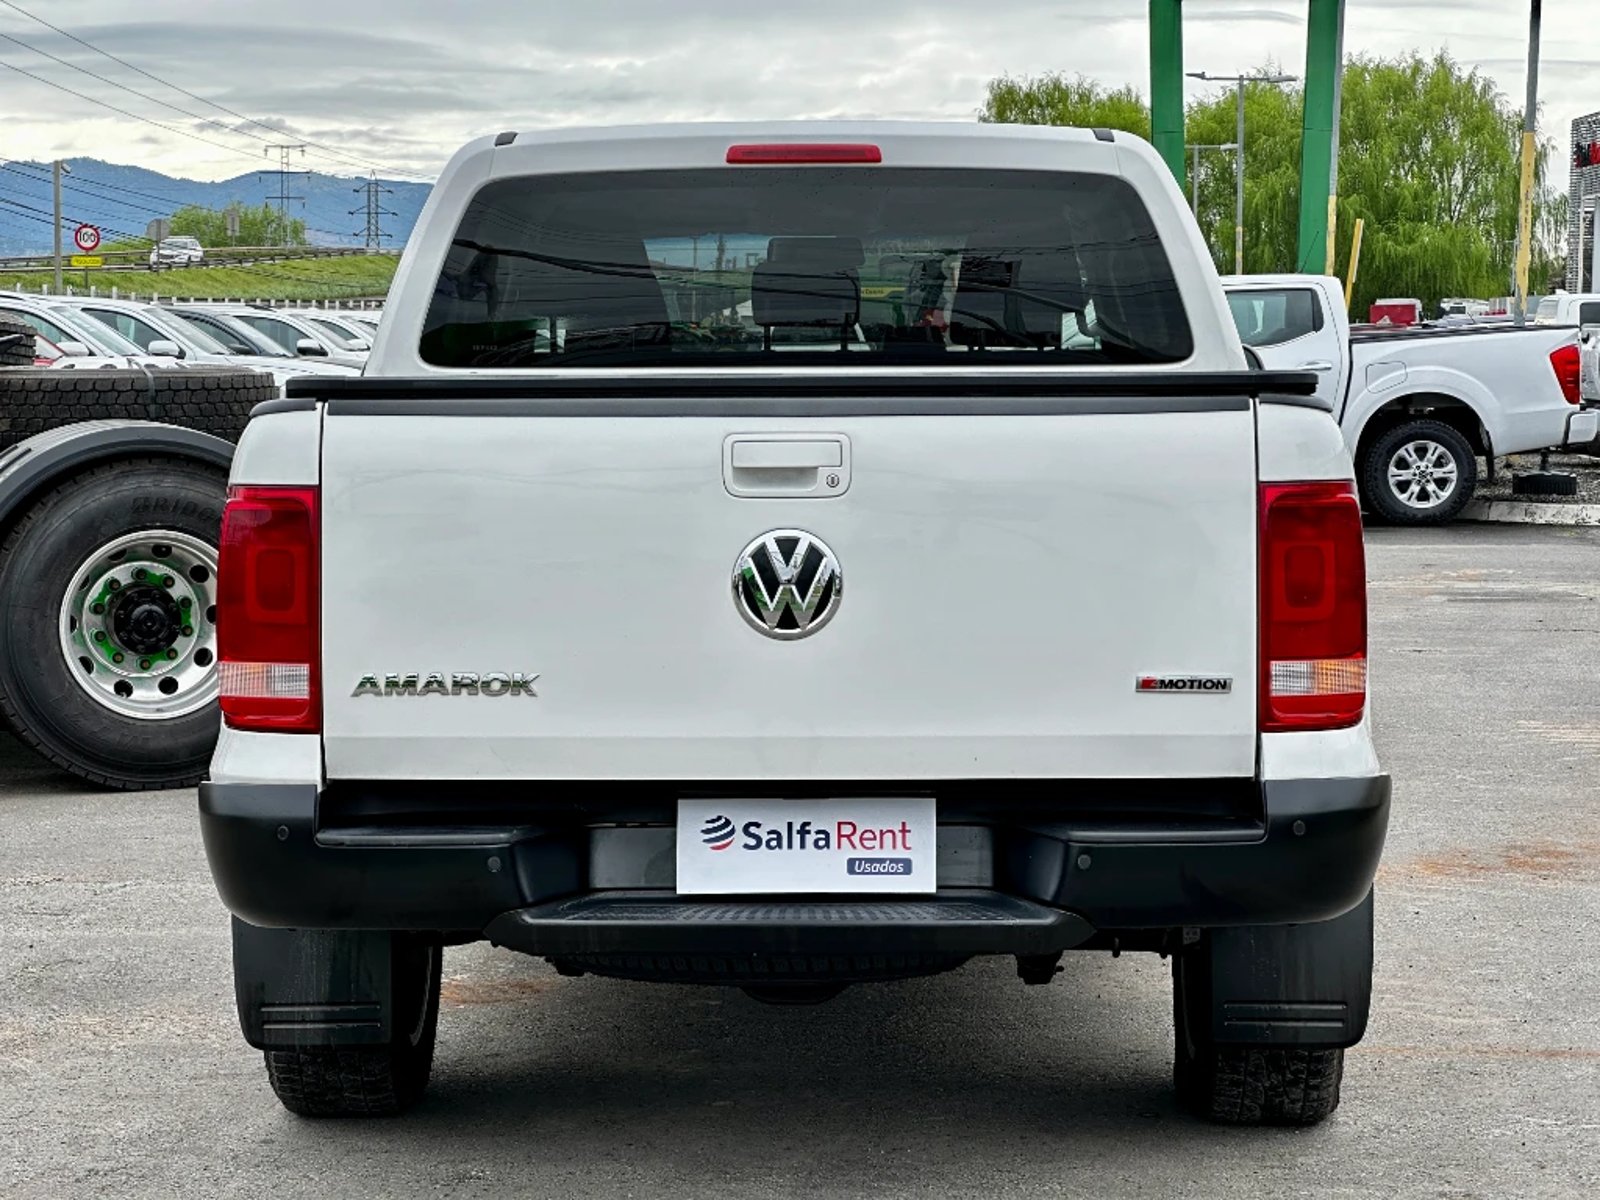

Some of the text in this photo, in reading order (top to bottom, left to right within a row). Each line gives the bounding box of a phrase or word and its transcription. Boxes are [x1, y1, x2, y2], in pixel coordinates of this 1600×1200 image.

[79, 230, 96, 243] 100
[350, 671, 541, 697] AMAROK
[741, 820, 912, 851] SalfaRent
[854, 859, 904, 873] Usados
